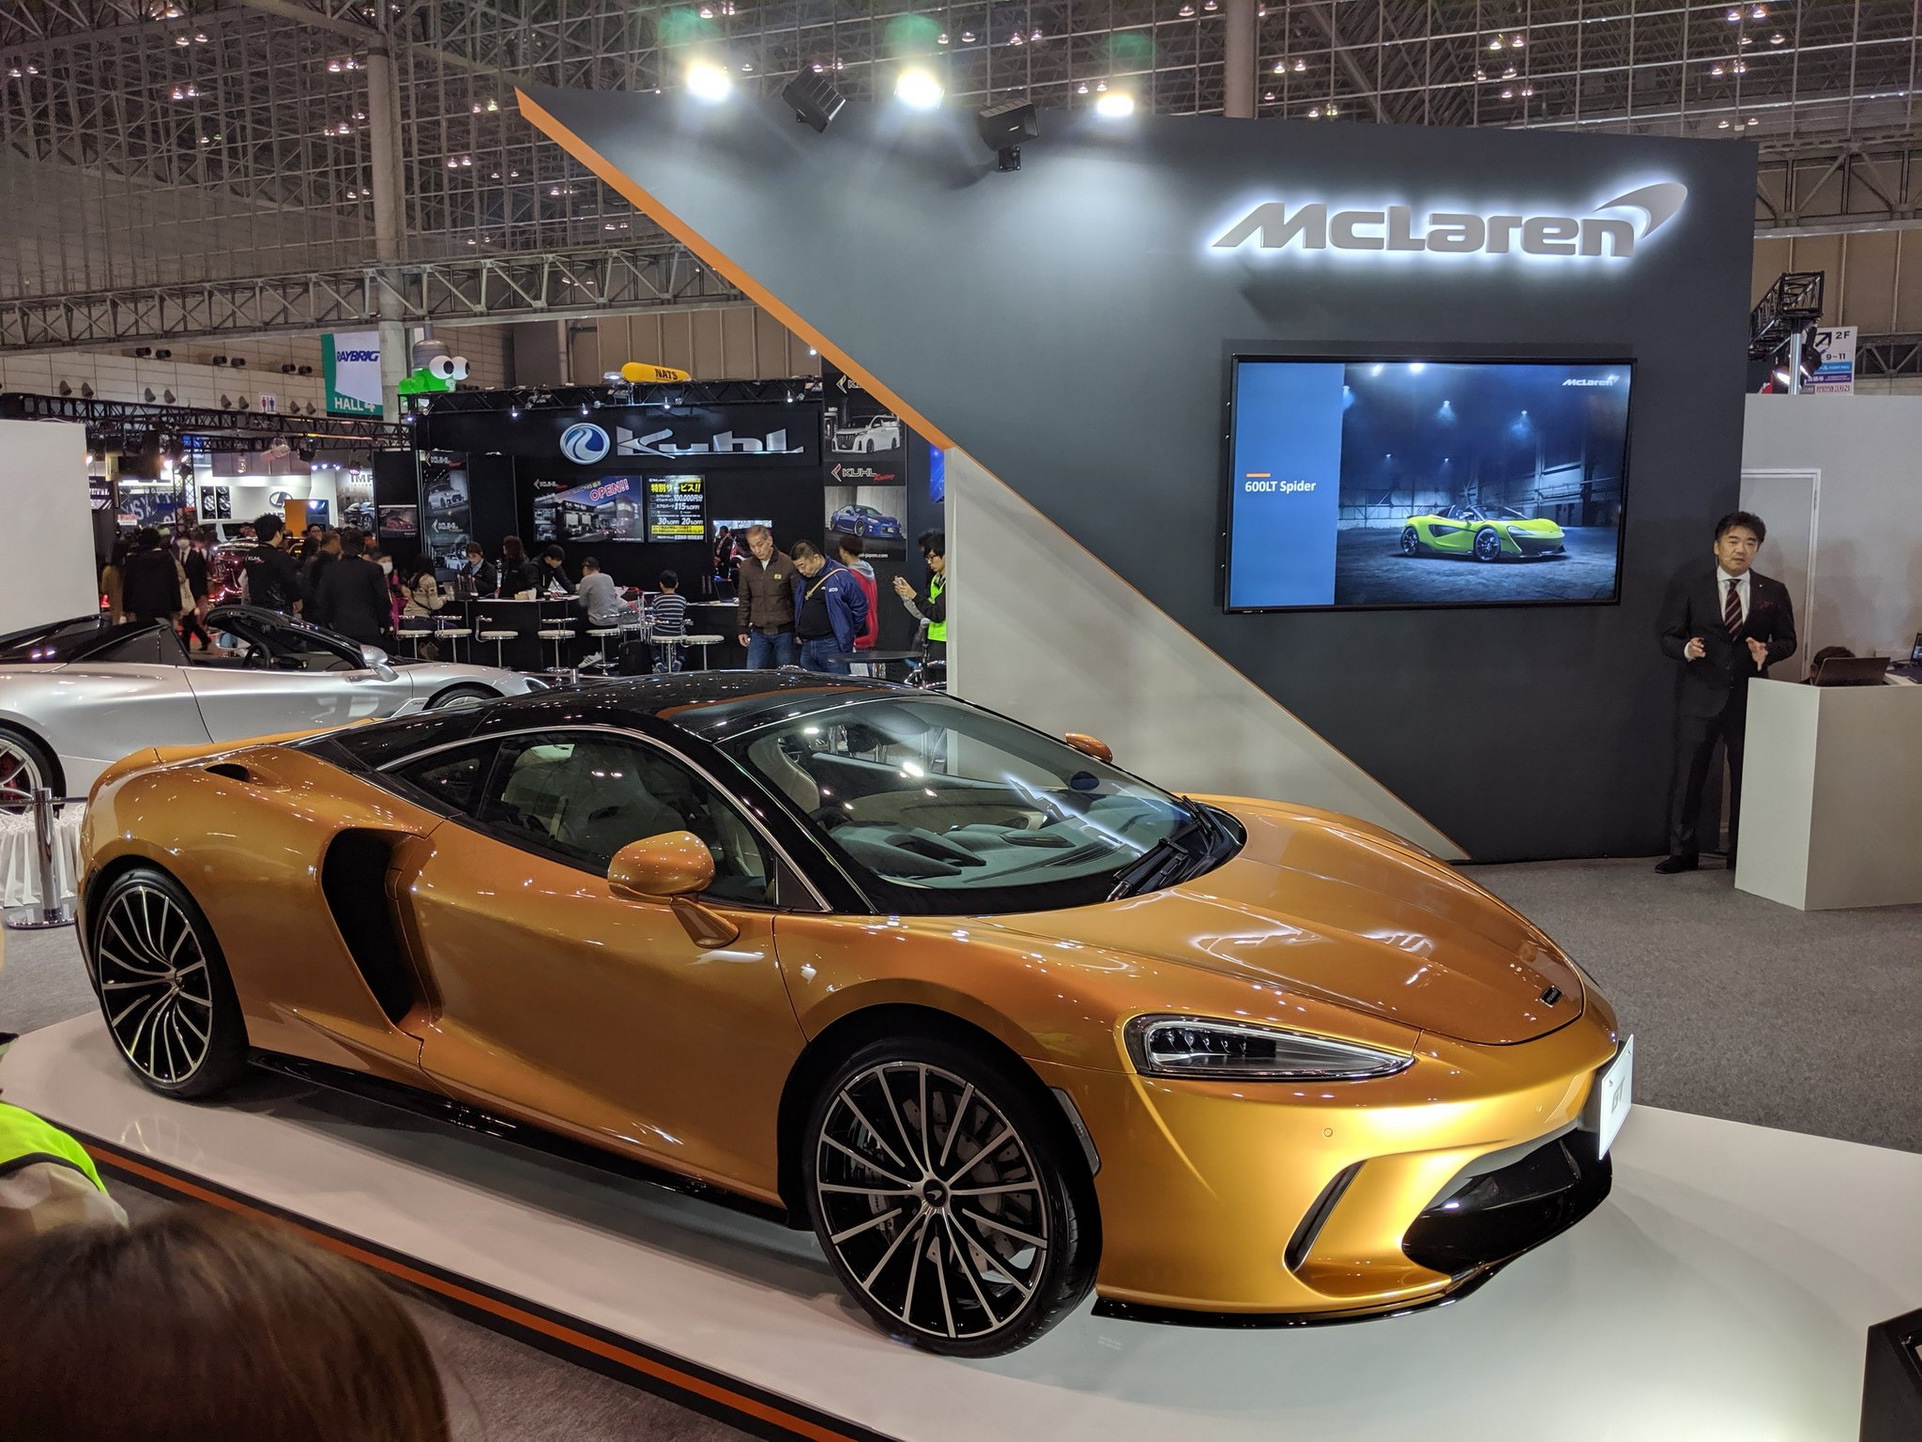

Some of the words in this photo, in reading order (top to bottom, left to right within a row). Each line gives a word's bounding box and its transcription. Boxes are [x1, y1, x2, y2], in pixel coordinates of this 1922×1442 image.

[1211, 202, 1635, 258] McLaren
[1835, 331, 1851, 340] 2F
[655, 368, 678, 380] NATS
[1561, 378, 1614, 386] McLaren
[334, 397, 364, 411] HALL
[364, 402, 376, 412] 4
[842, 467, 877, 478] KUHL
[1245, 481, 1278, 492] 600LT
[1280, 480, 1317, 494] Spider
